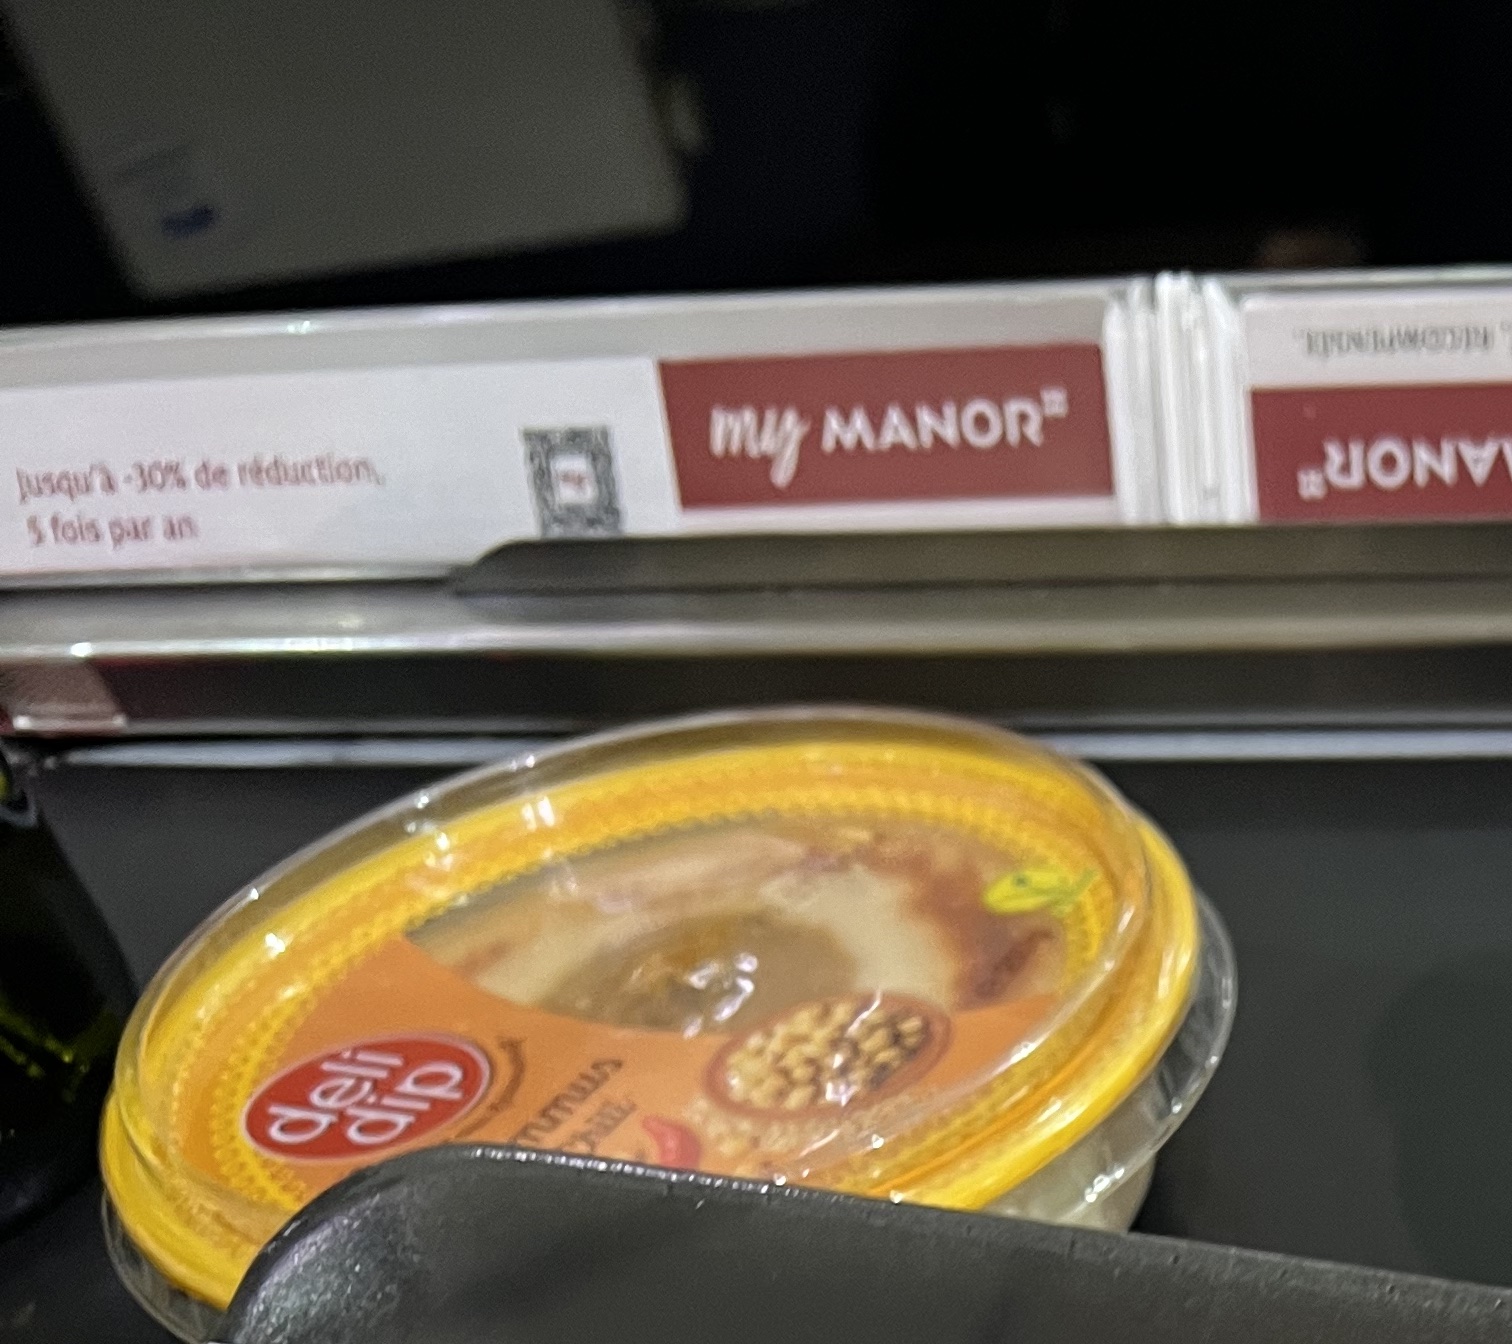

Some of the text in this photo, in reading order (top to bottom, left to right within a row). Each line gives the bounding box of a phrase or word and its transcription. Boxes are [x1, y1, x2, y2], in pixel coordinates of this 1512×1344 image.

[123, 459, 187, 495] -30%
[194, 455, 230, 491] de
[710, 394, 1046, 489] my MANOR
[50, 512, 100, 545] fois
[109, 514, 153, 551] par
[163, 514, 198, 541] an
[268, 1050, 404, 1145] deli
[345, 1060, 464, 1145] dip
